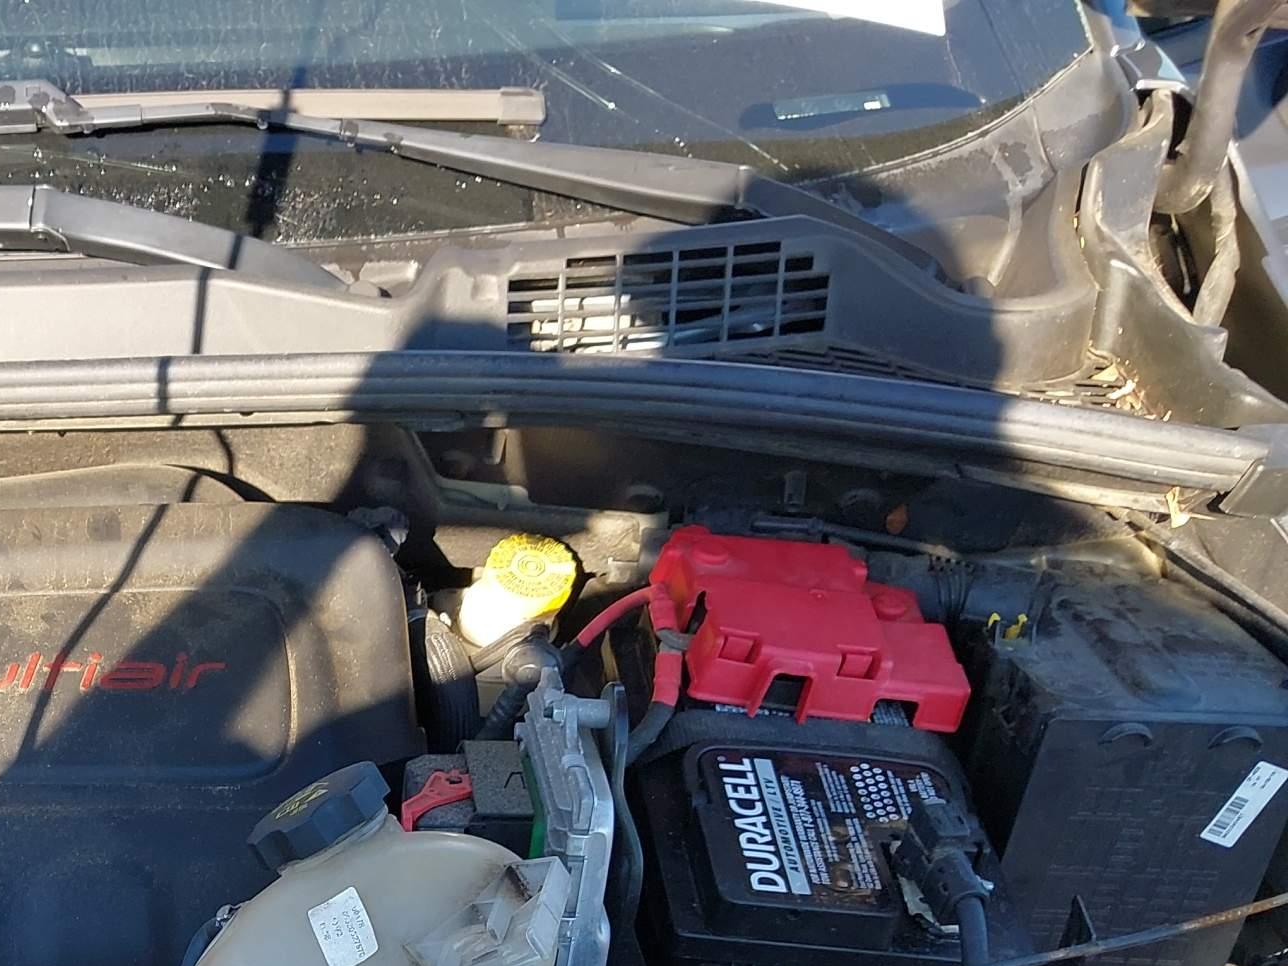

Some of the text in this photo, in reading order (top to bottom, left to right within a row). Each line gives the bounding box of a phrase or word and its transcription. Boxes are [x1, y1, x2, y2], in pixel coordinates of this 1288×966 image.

[762, 777, 777, 796] LTV
[718, 758, 789, 893] DURACELL
[771, 806, 800, 873] AUTOMOTIVE
